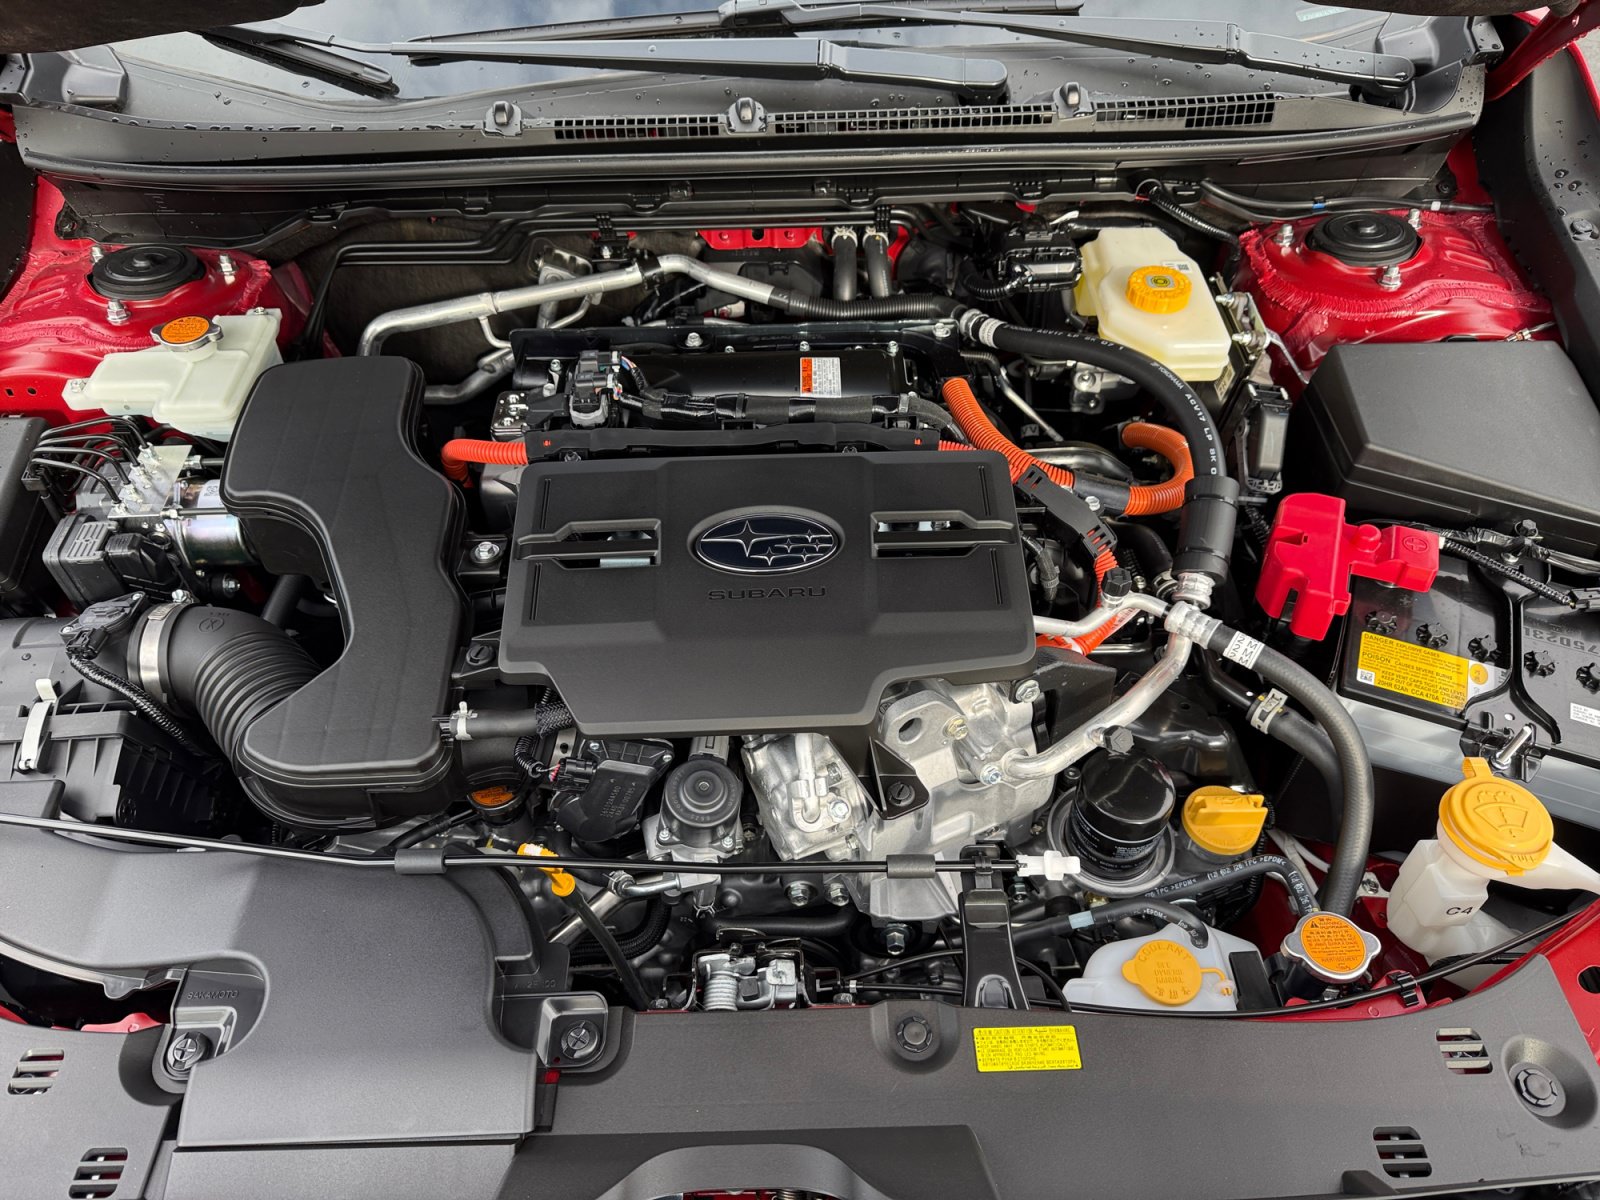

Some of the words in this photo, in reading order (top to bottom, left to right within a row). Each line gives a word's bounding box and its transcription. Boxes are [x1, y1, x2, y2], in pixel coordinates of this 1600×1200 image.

[1184, 393, 1207, 422] ACV17
[707, 586, 827, 600] SUBARU
[1364, 633, 1394, 646] DANGER
[1362, 651, 1391, 664] POISON
[1446, 905, 1473, 915] C4
[1138, 942, 1192, 963] COOLANT
[186, 989, 240, 999] SAKAMOTO
